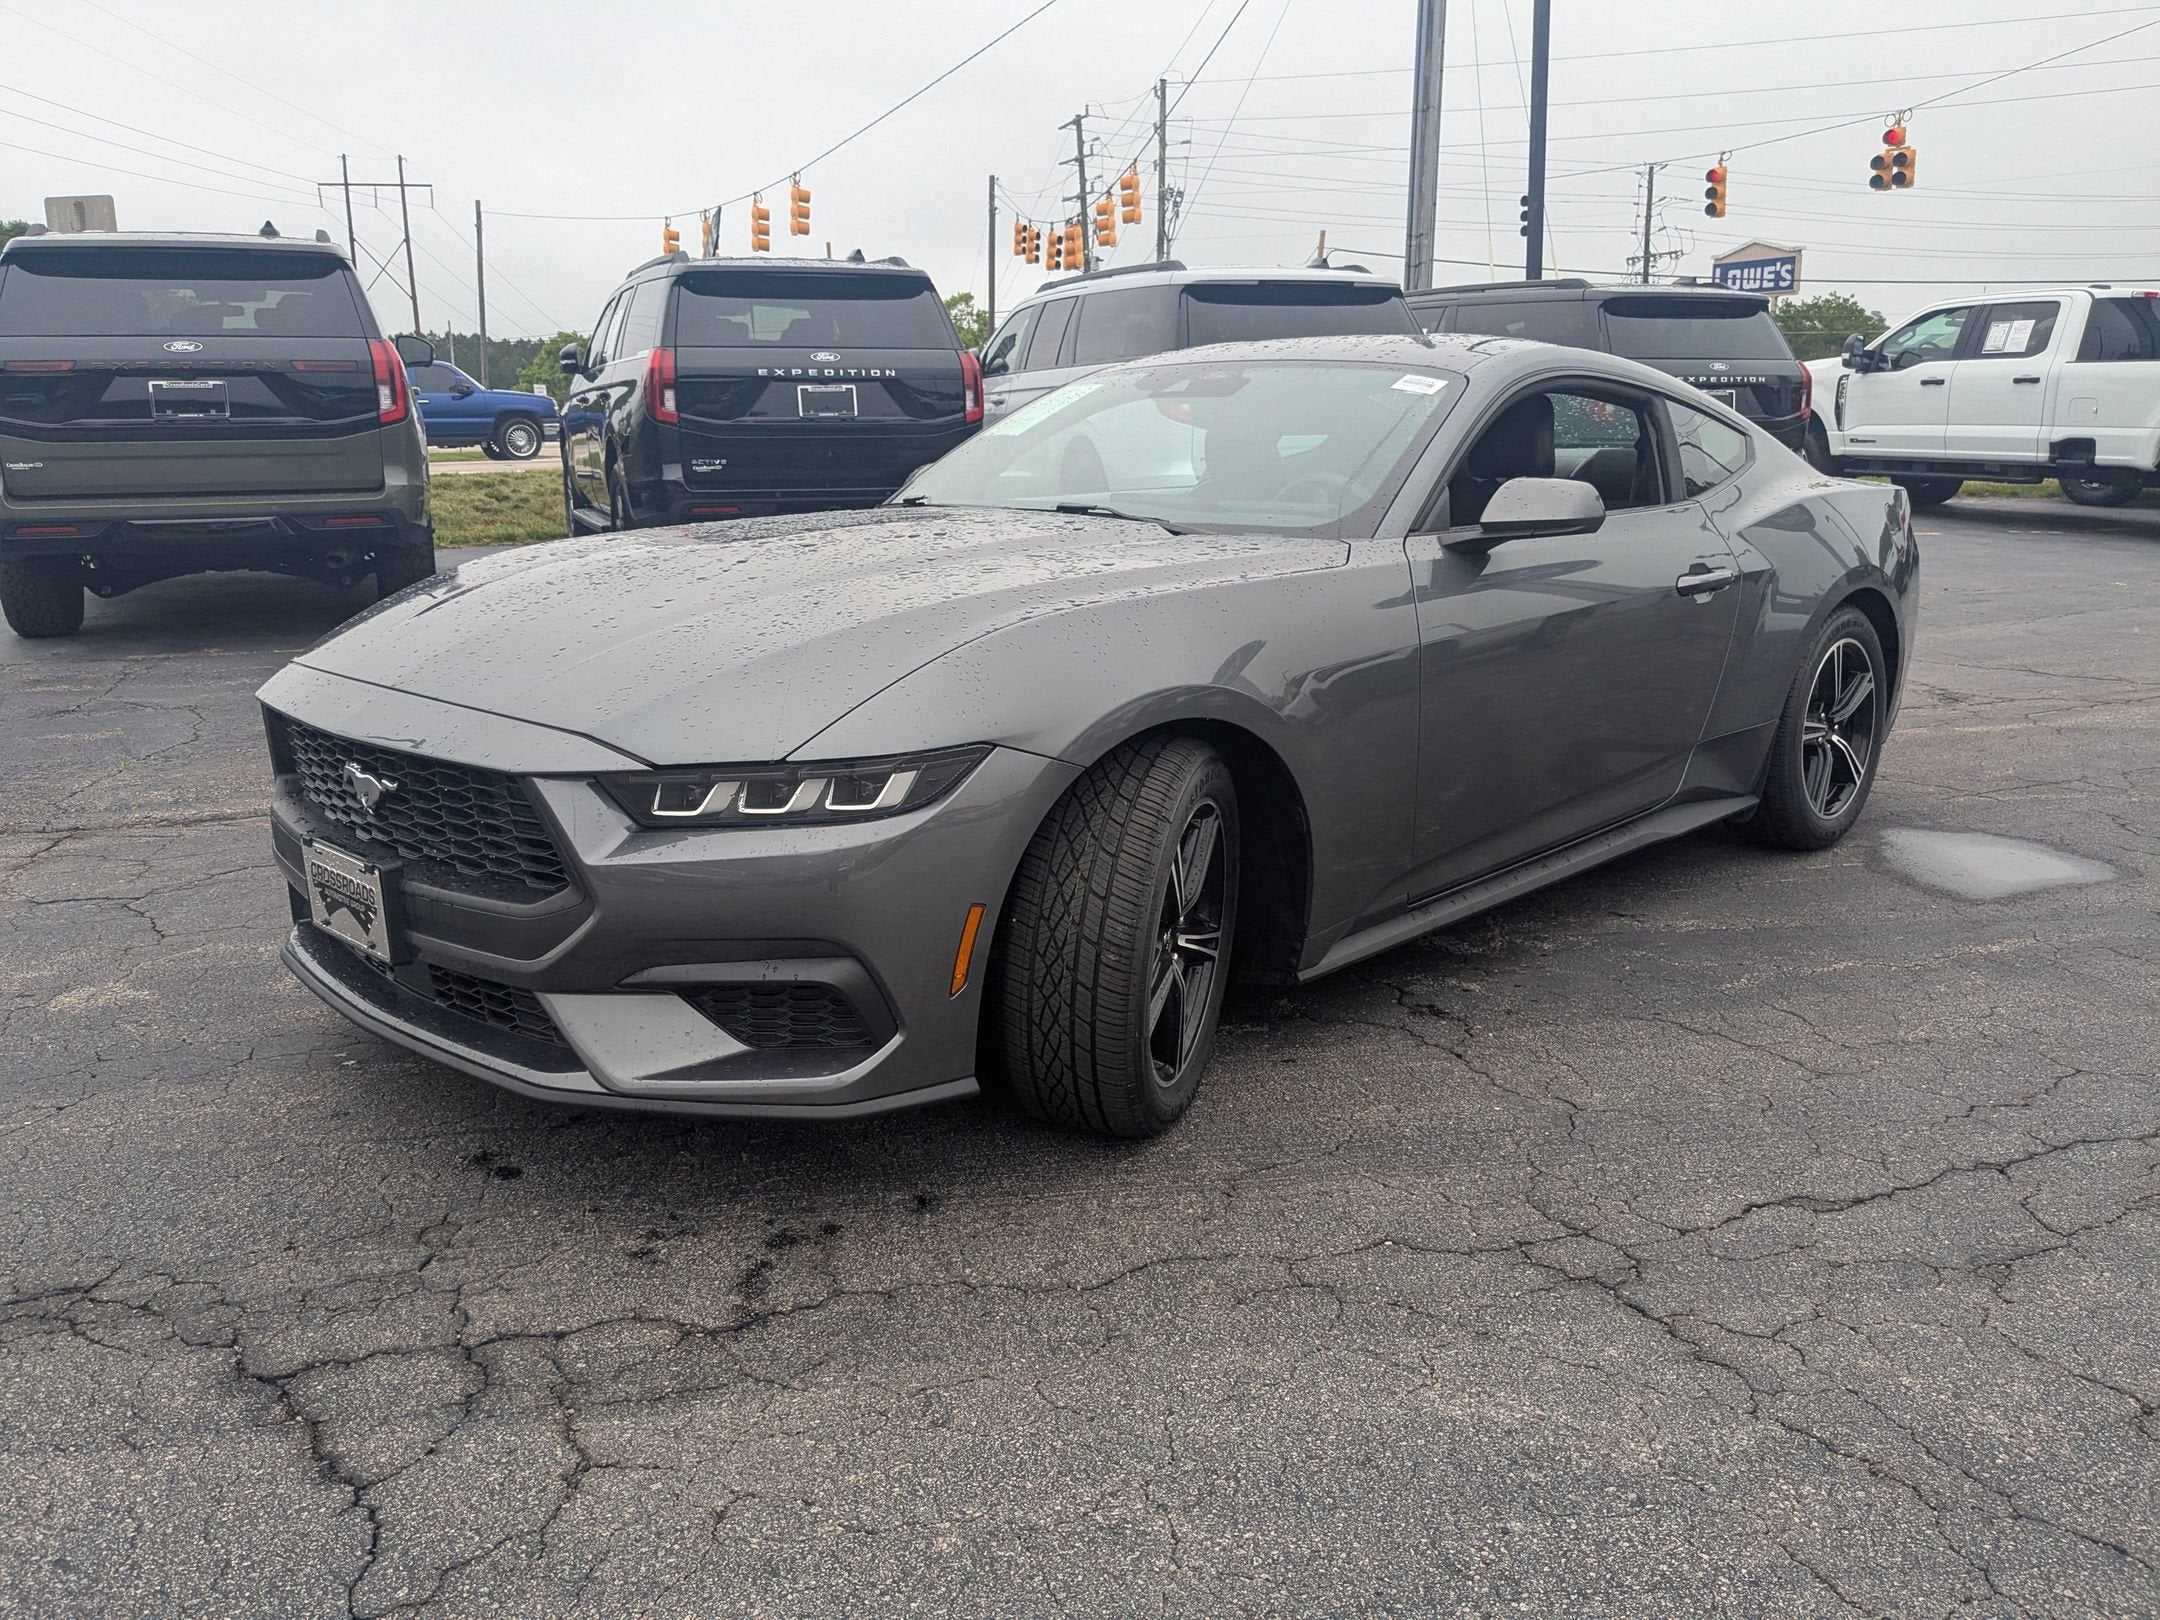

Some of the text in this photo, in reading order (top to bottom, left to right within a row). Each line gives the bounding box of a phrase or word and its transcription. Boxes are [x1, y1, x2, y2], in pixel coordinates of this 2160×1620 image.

[167, 341, 199, 352] Ford
[813, 352, 838, 361] Ford
[91, 361, 277, 370] EXPEDITION
[757, 368, 897, 377] EXPEDITION
[310, 861, 376, 905] CROSSROADS
[350, 900, 367, 911] GROUP
